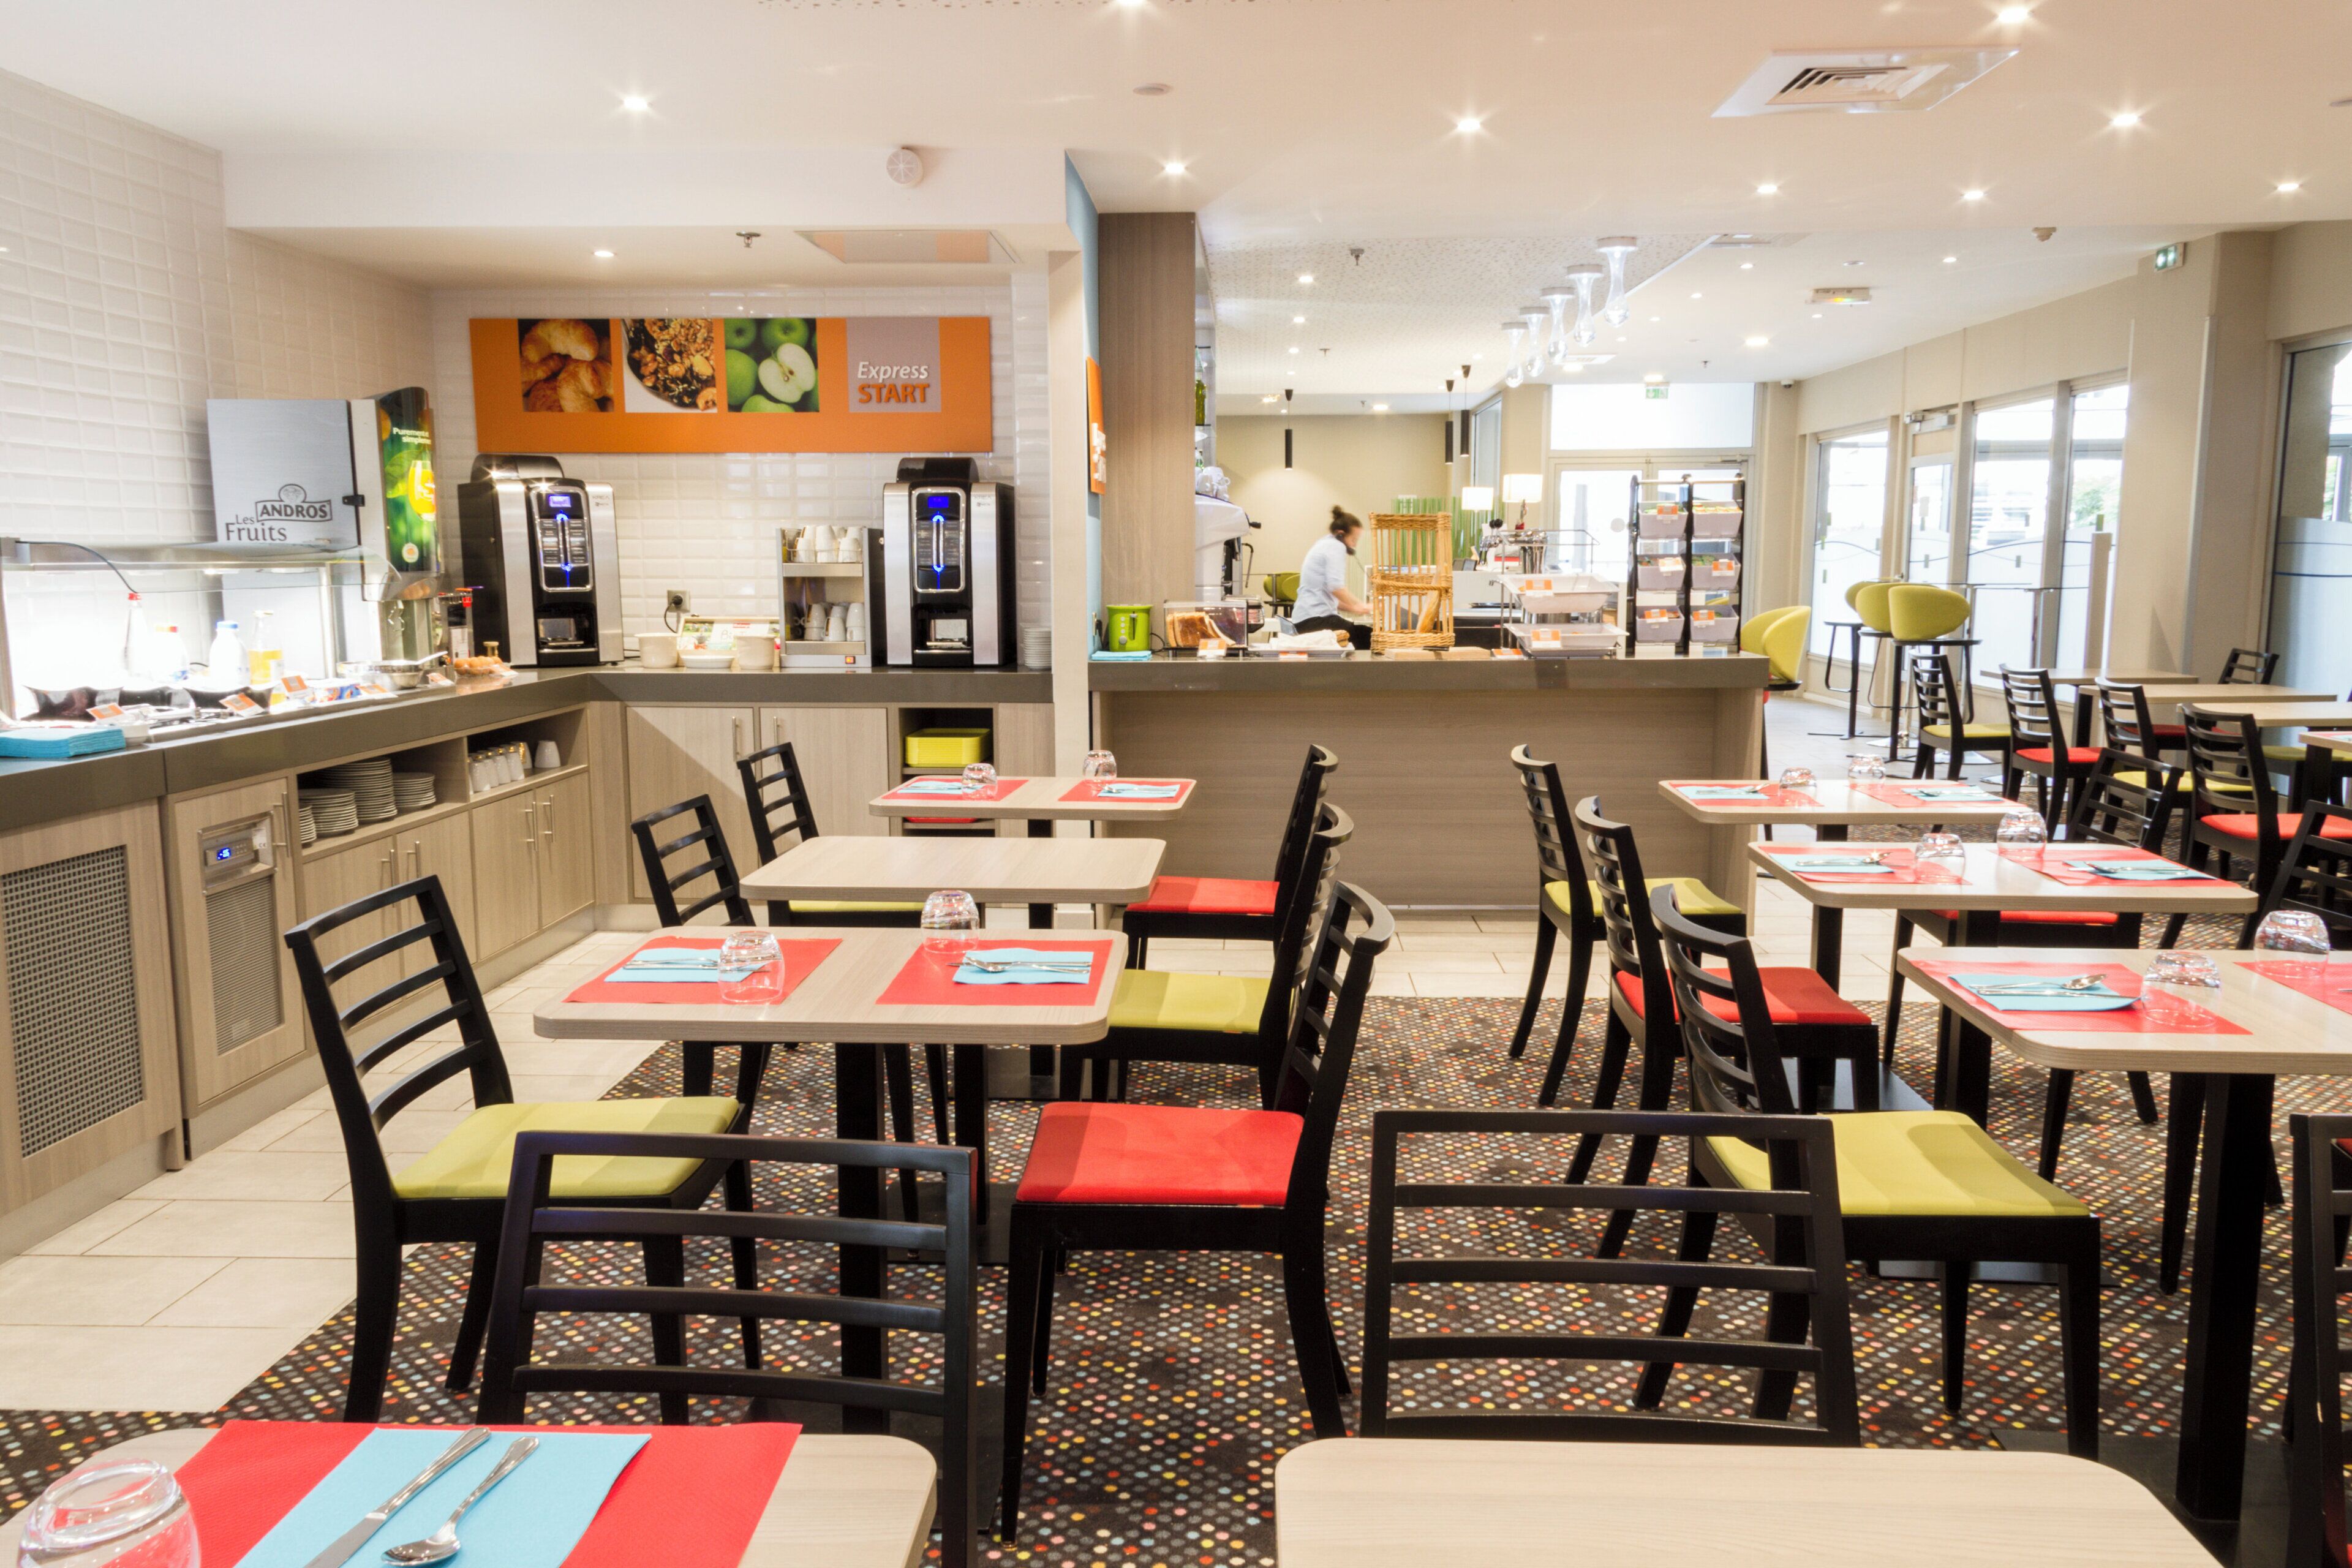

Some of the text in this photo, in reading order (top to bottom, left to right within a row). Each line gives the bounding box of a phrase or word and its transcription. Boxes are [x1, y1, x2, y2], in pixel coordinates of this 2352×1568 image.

[858, 361, 929, 383] Express
[858, 383, 930, 403] START
[235, 514, 255, 525] Les
[260, 503, 328, 519] ANDROS
[225, 522, 287, 541] Fruits
